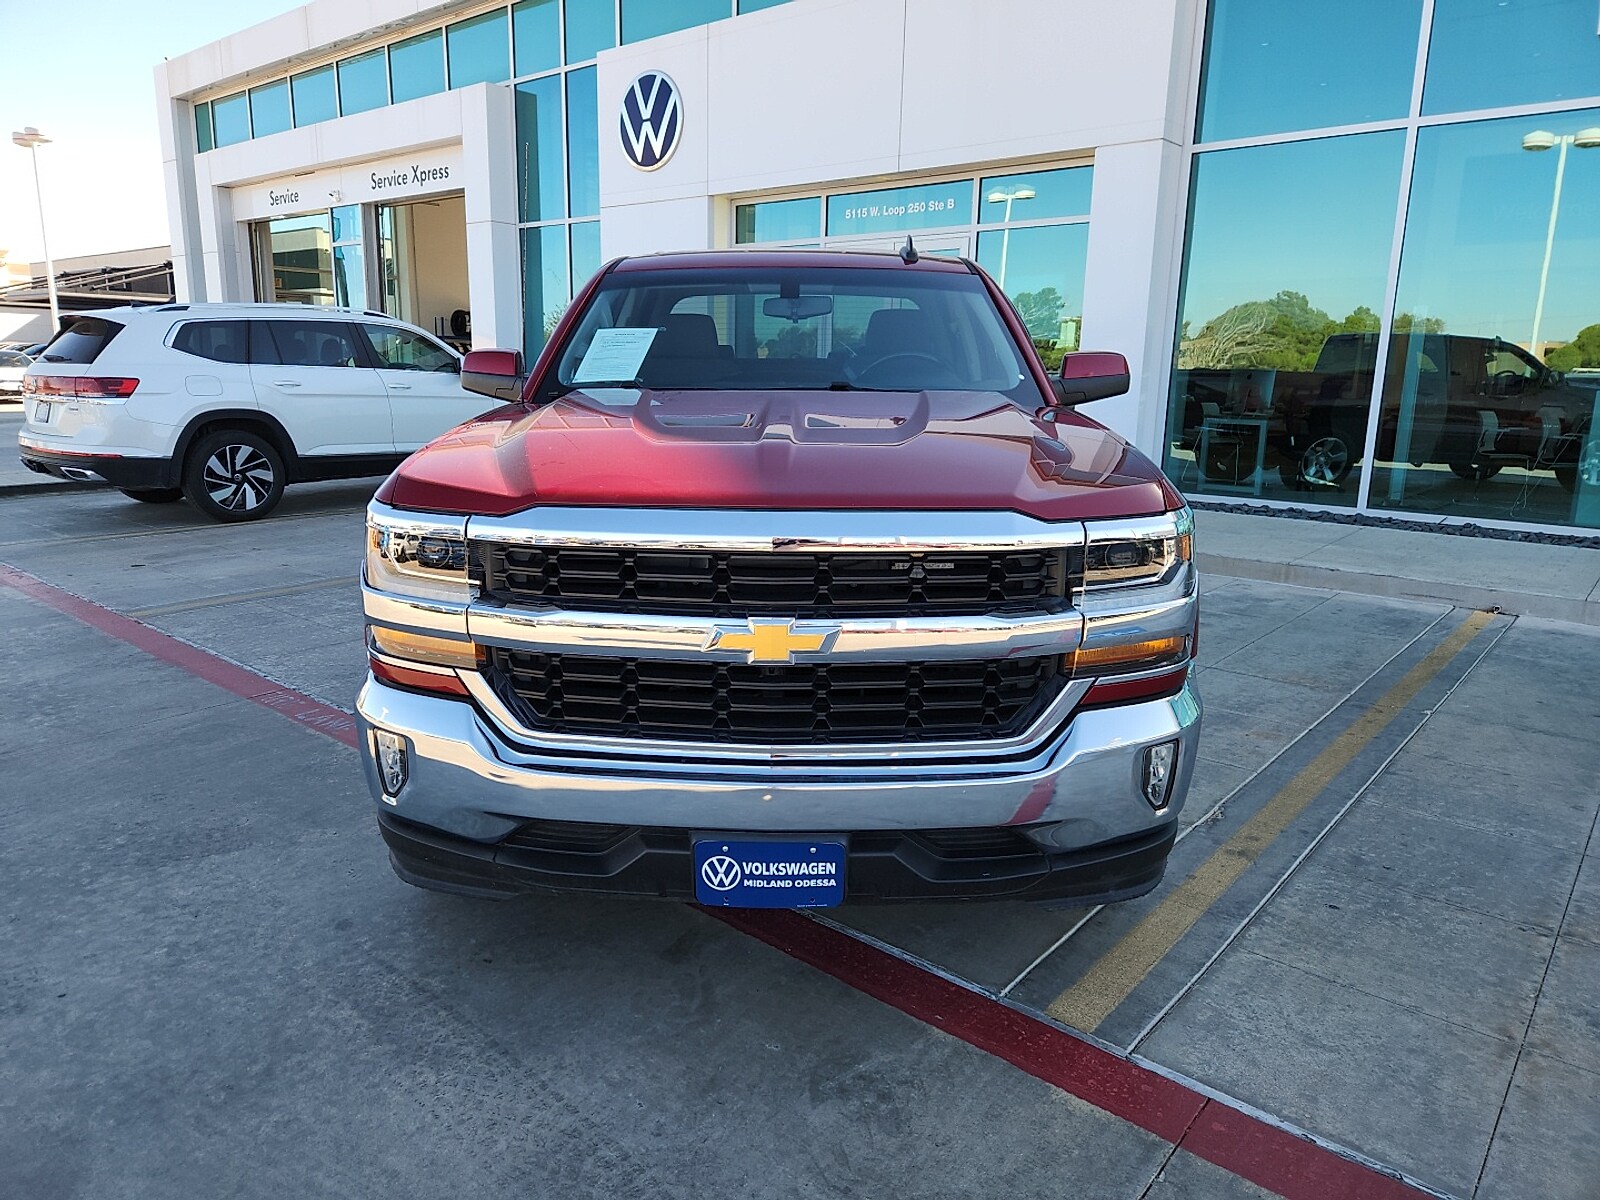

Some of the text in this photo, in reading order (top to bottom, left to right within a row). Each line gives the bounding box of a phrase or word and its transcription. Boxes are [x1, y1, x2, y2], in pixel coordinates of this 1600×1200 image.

[371, 165, 449, 190] Service Xpress
[269, 189, 299, 207] Service
[845, 198, 955, 219] 5115 W. Loop 250 Ste B
[742, 862, 836, 876] VOLKSWAGEN
[743, 878, 837, 888] MIDLAND ODESSA
